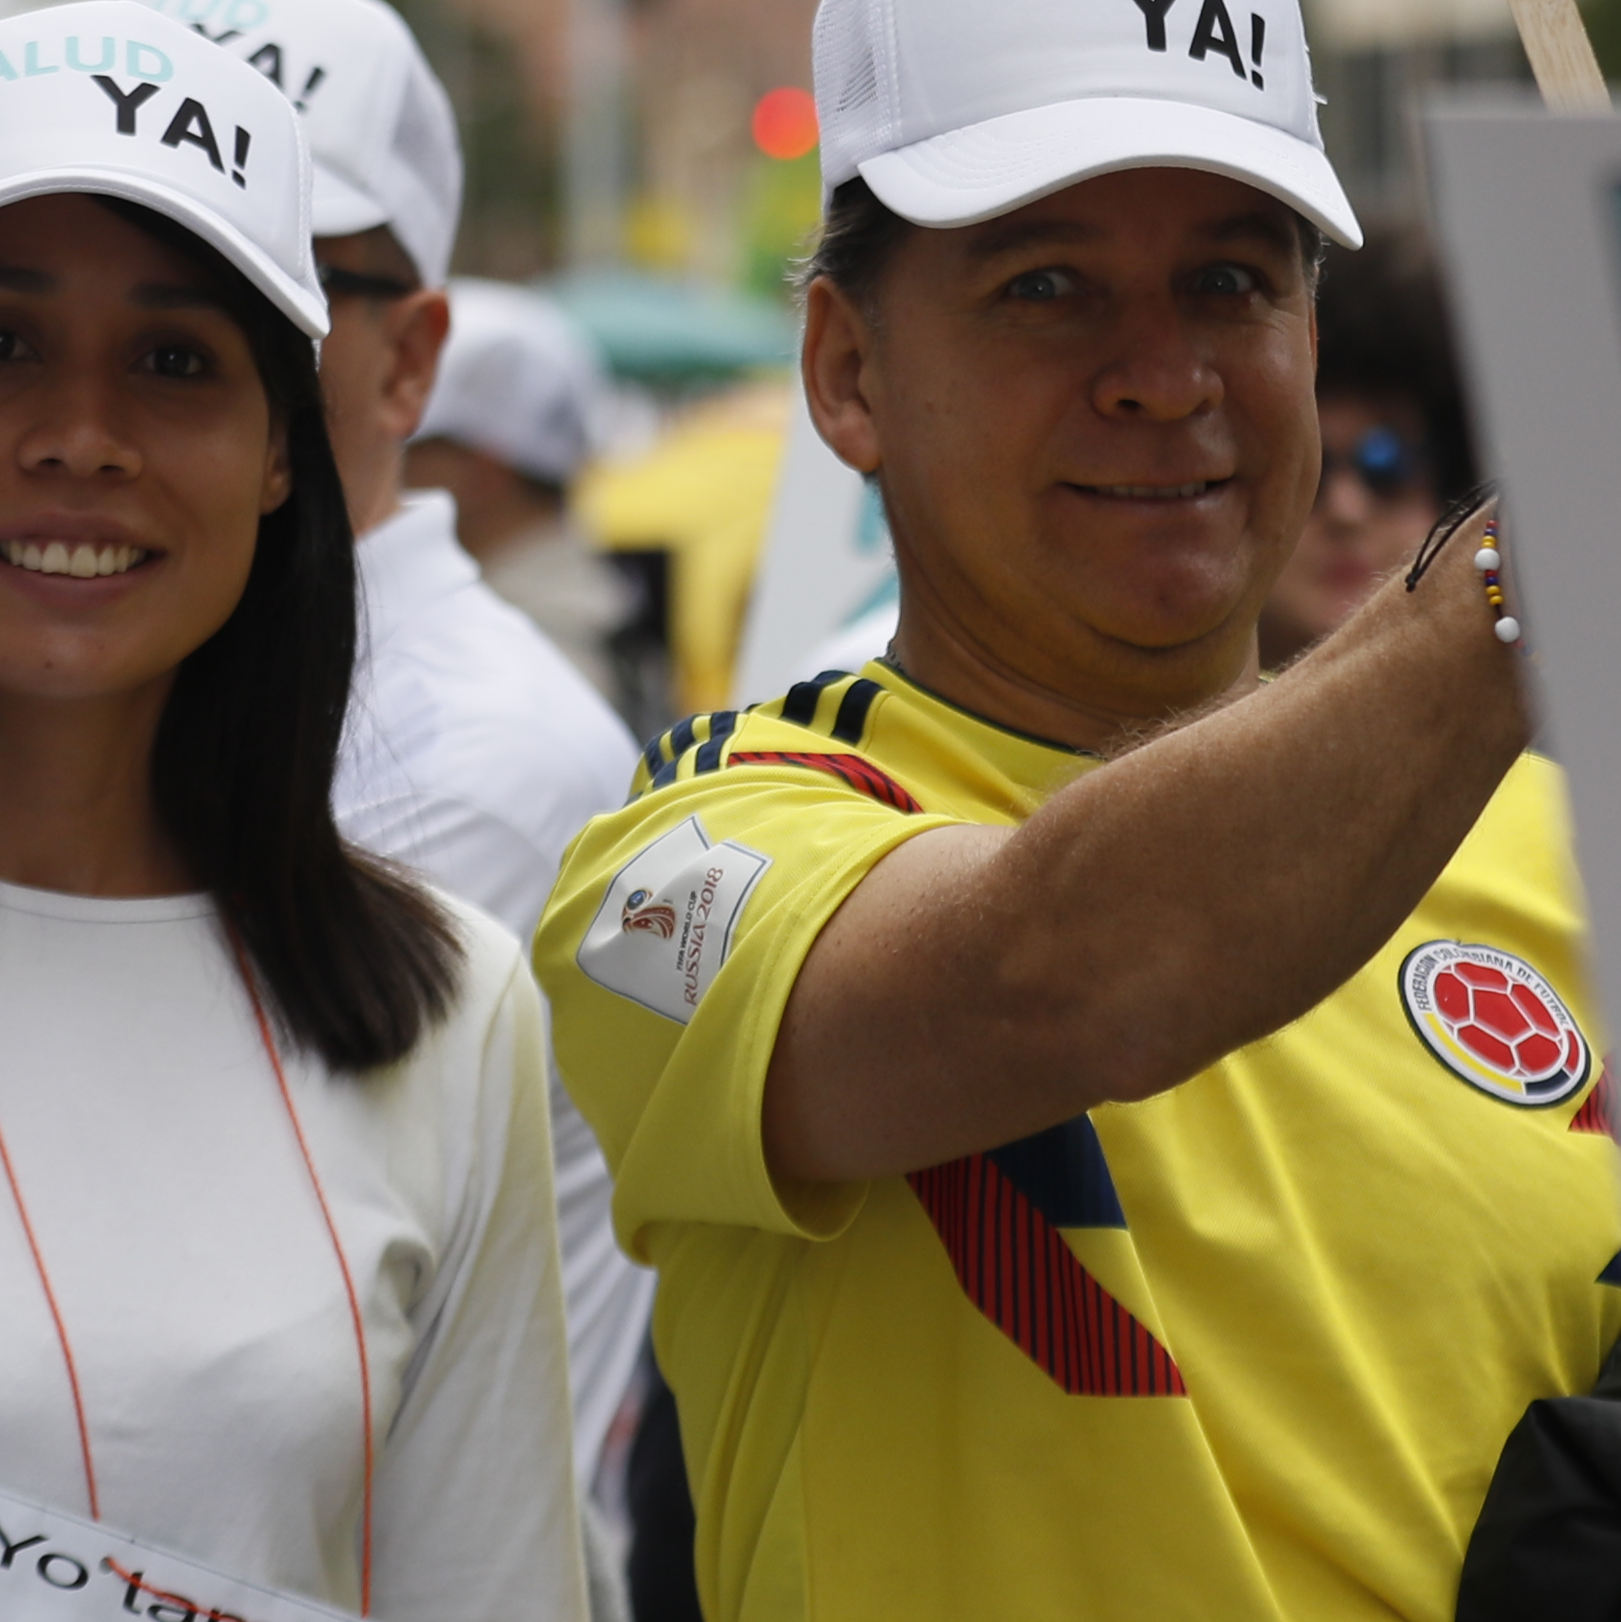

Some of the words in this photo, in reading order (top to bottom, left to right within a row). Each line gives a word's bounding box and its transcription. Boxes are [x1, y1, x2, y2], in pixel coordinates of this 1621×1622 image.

[90, 73, 252, 190] YA!
[687, 890, 698, 911] CUP
[684, 923, 707, 1007] RUSSIA
[697, 867, 724, 921] 2018
[1516, 965, 1534, 986] DE
